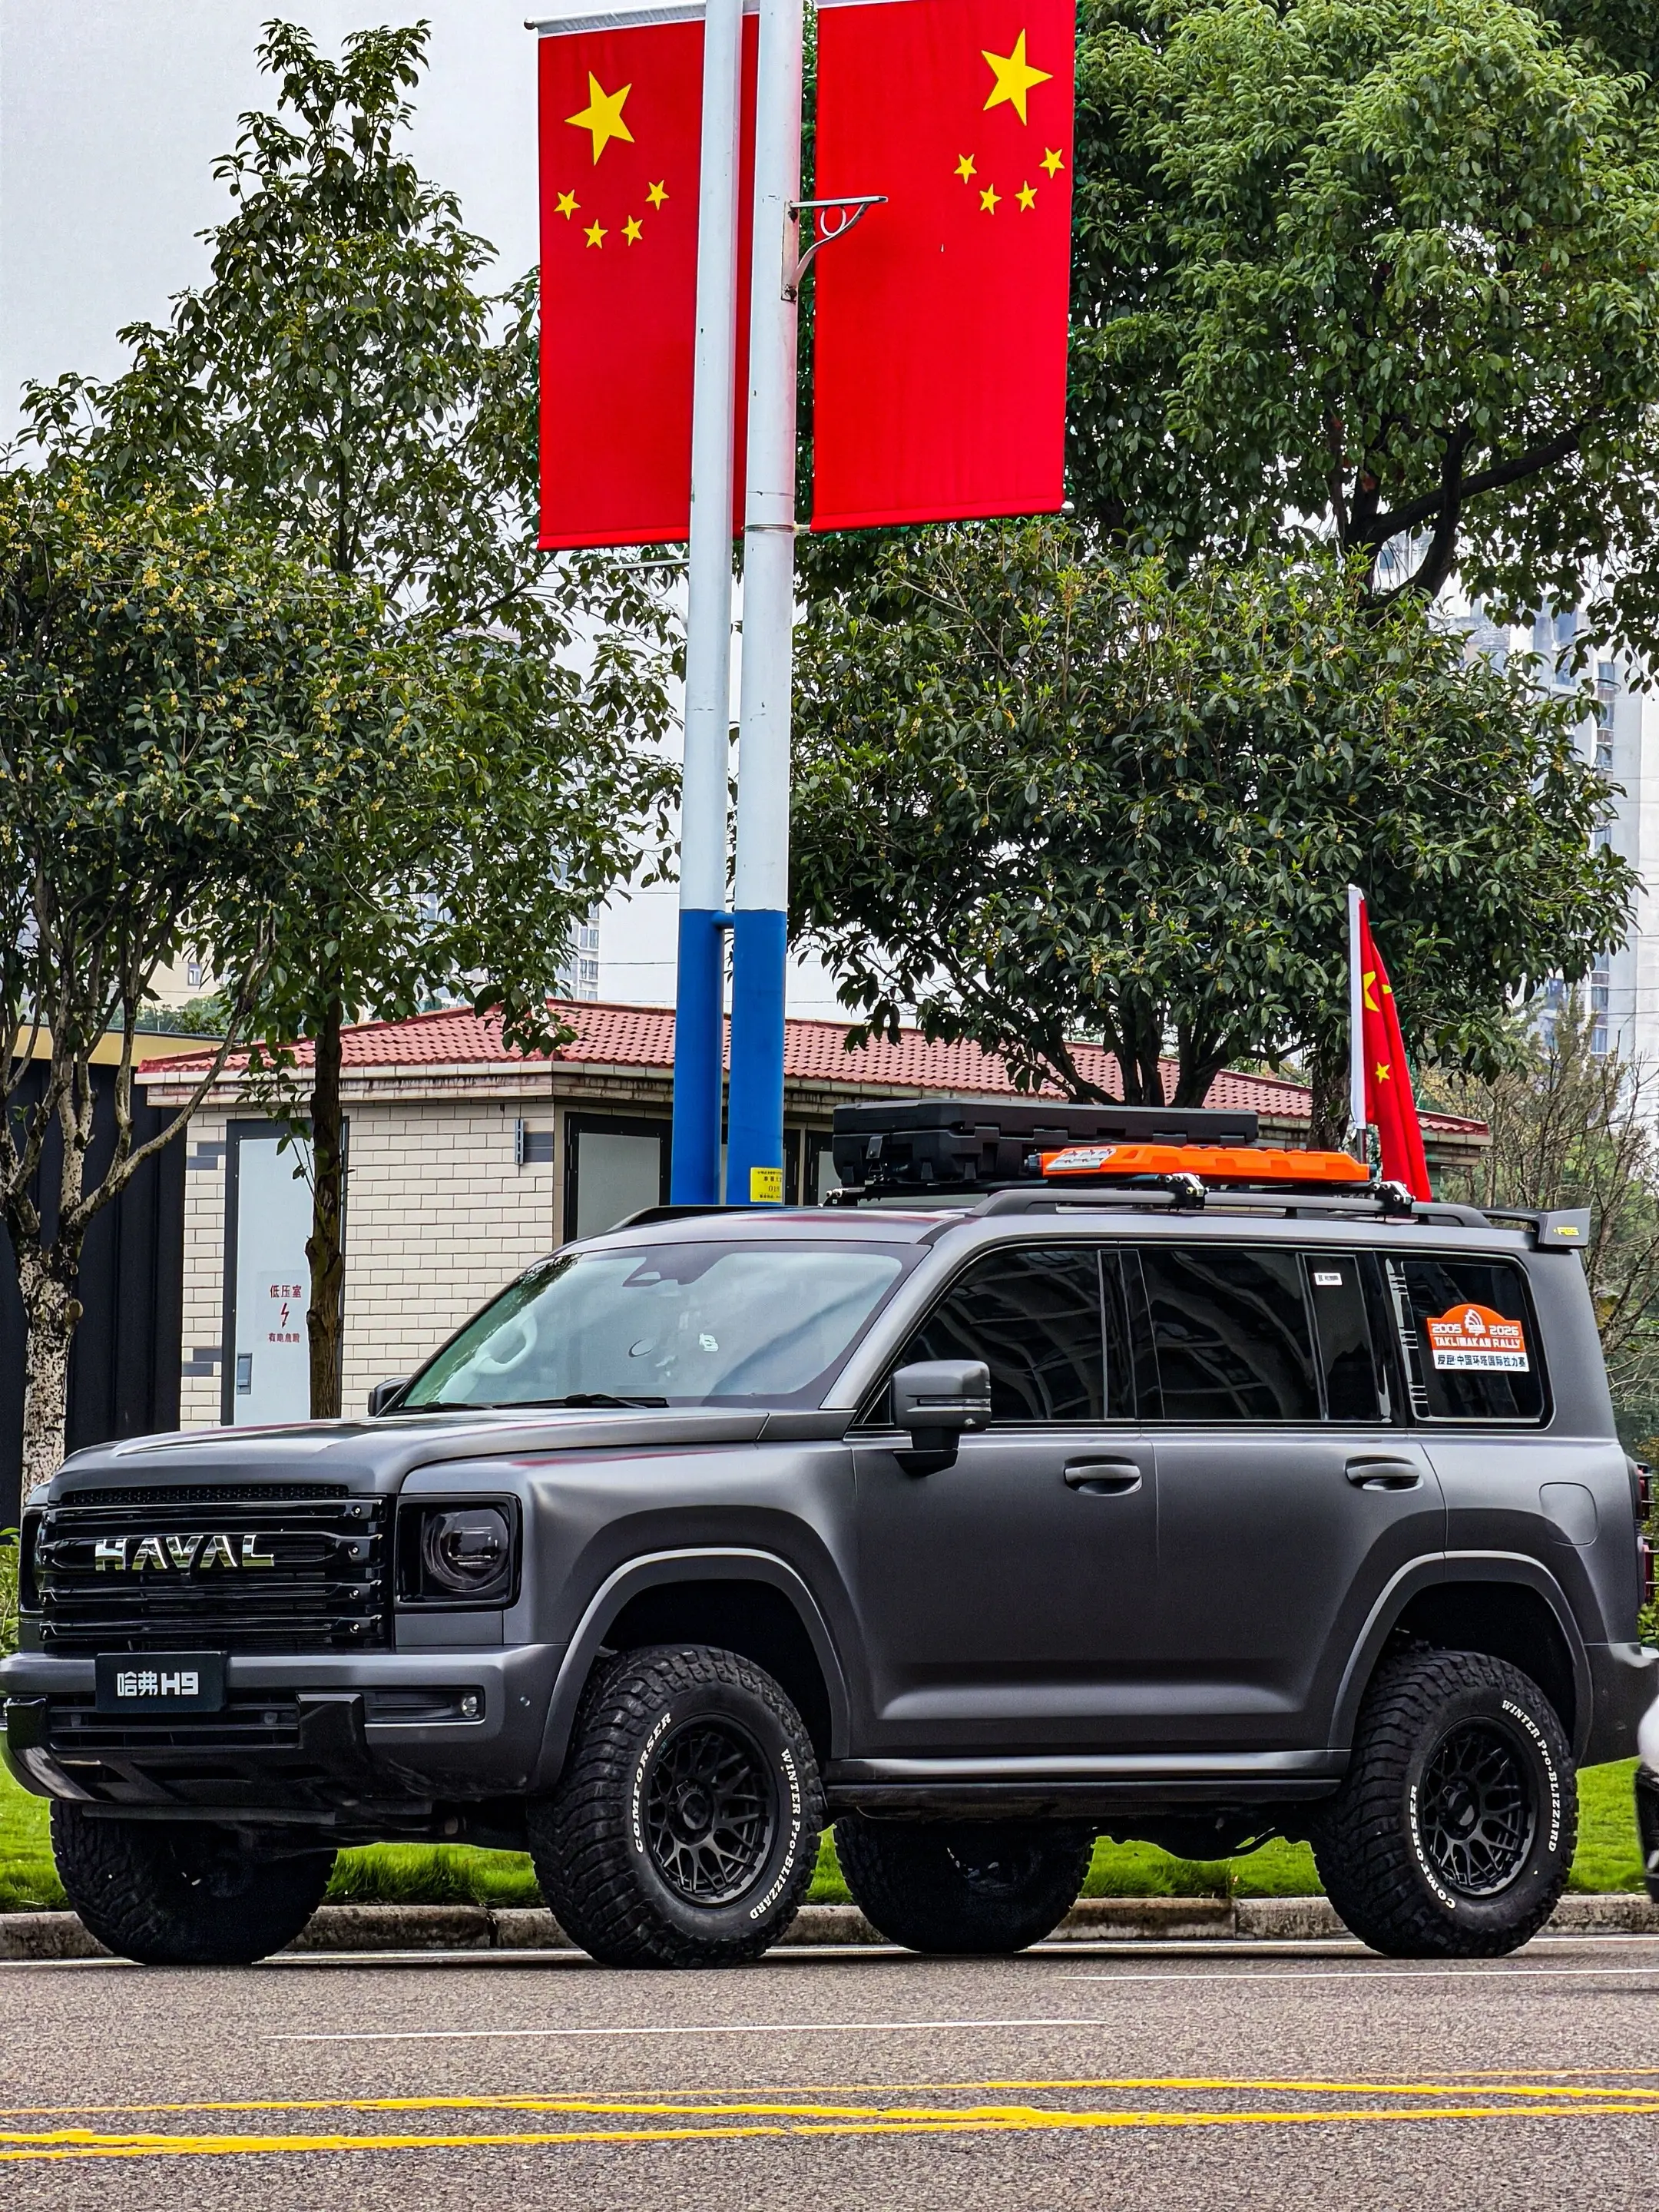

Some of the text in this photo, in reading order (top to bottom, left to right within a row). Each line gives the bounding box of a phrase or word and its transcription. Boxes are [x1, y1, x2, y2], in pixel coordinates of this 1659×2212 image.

[270, 1284, 302, 1299] 低压室
[1433, 1336, 1522, 1349] TAKLIMAKAN RALLY
[1488, 1325, 1519, 1336] 2026
[95, 1535, 275, 1571] HAVAL
[1502, 1700, 1541, 1739] WINTER
[632, 1712, 672, 1854] COMFORSER
[780, 1748, 801, 1815] WINTER
